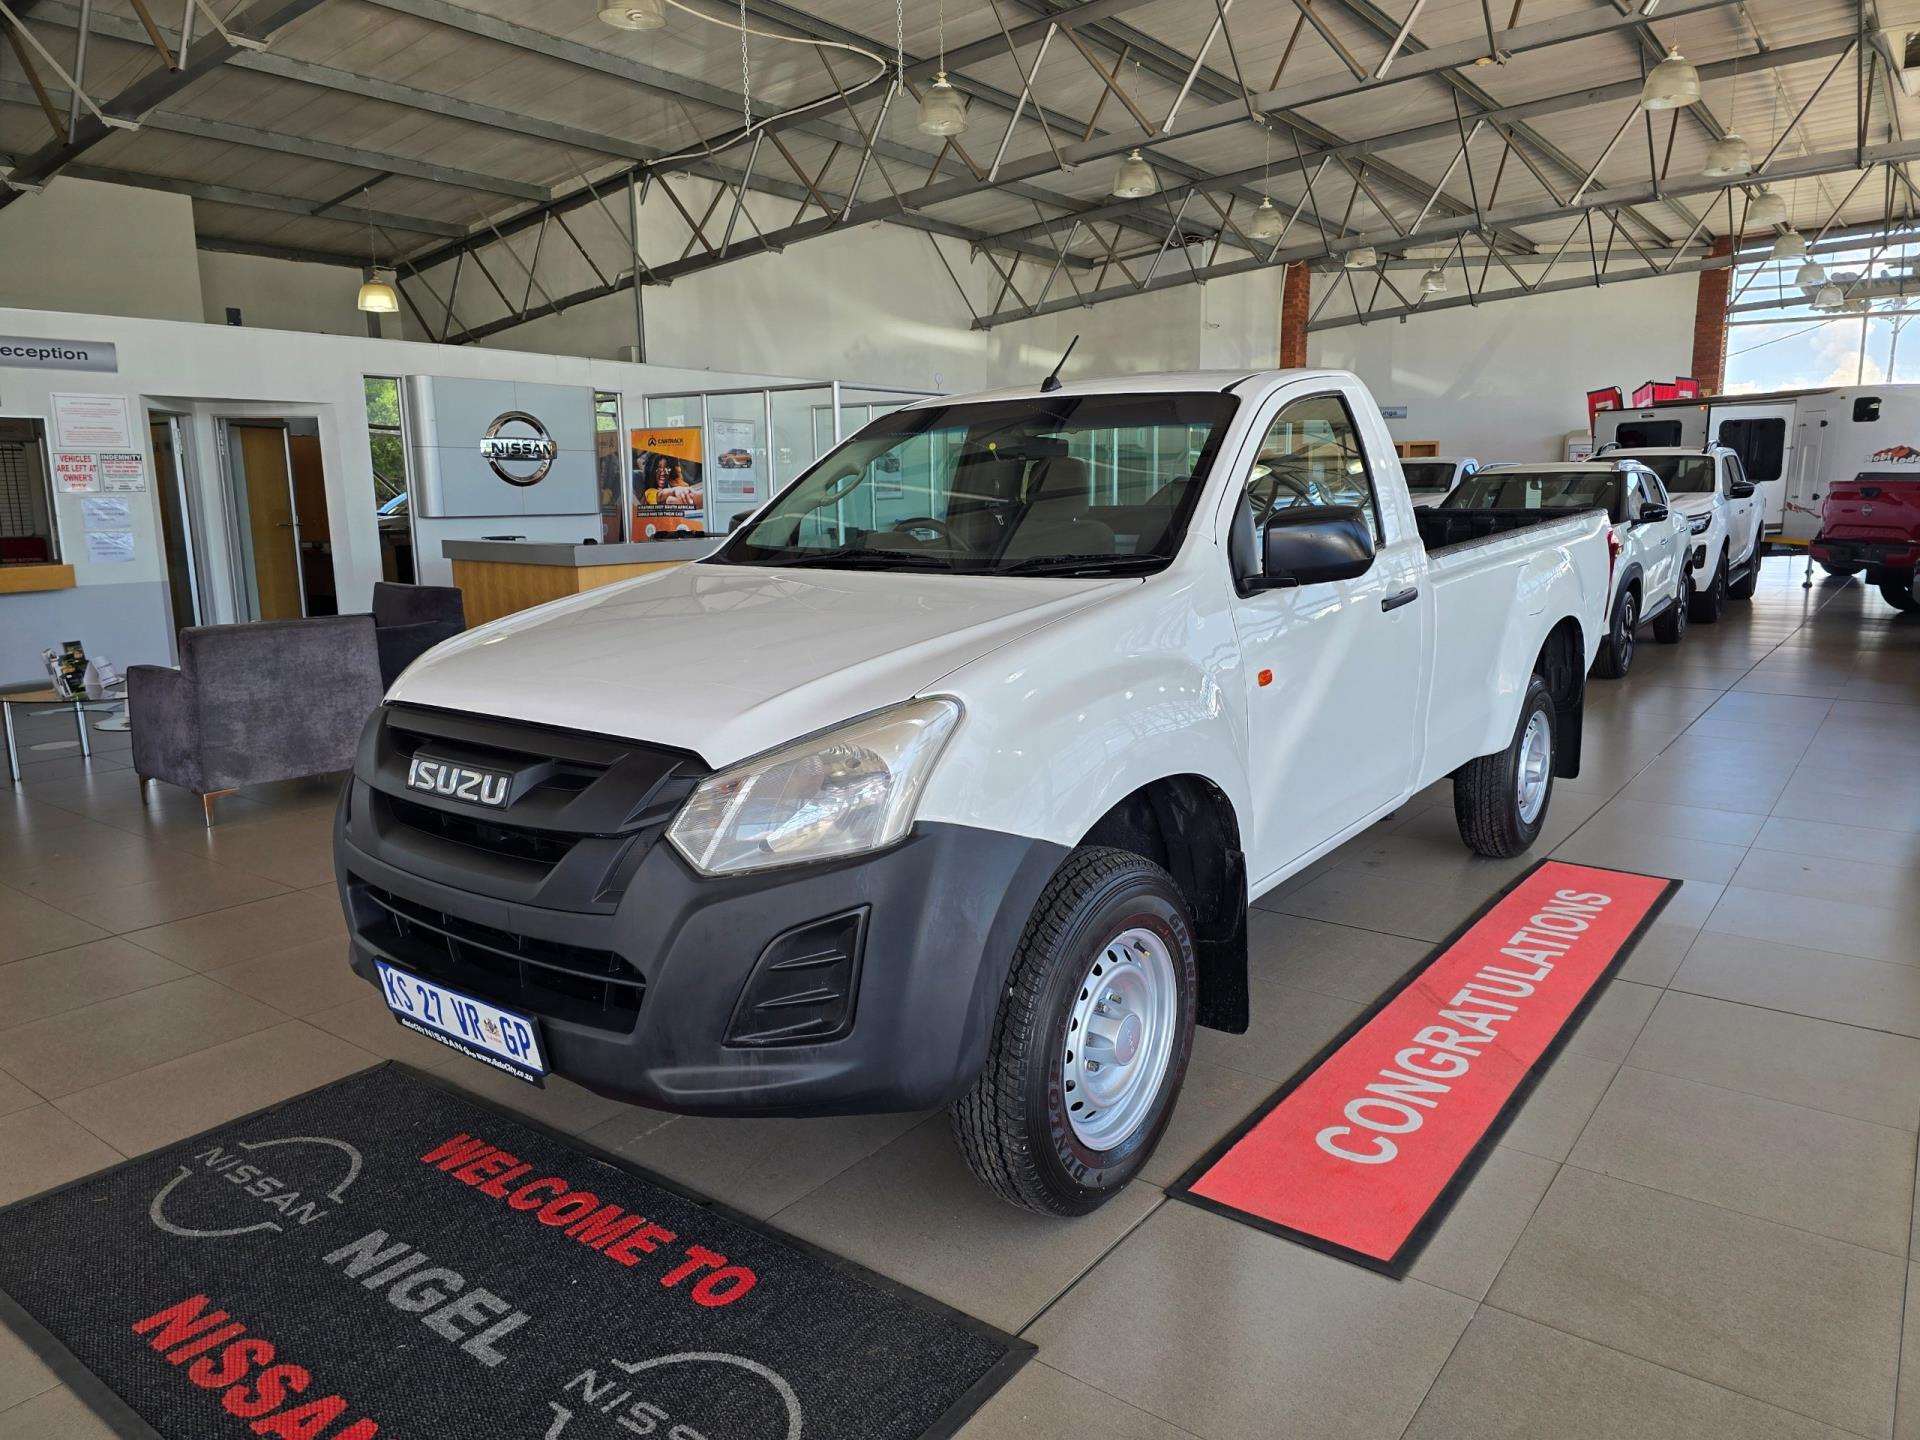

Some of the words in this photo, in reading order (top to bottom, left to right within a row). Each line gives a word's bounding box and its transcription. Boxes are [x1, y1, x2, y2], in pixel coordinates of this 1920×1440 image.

[0, 346, 88, 360] eception
[57, 464, 70, 473] ARE
[71, 464, 87, 473] LEFT
[89, 464, 97, 473] AT
[60, 455, 92, 463] VEHICLES
[491, 442, 551, 455] NISSAN
[63, 474, 93, 482] OWNER'S
[408, 758, 508, 806] ISUZU
[385, 967, 414, 1012] KS
[417, 984, 444, 1026] 27
[450, 998, 486, 1043] VR
[499, 1016, 531, 1061] GP
[1315, 889, 1612, 1165] CONGRATULATIONS
[425, 1029, 464, 1053] NISSAN
[195, 1146, 329, 1226] NISSAN
[420, 1133, 677, 1267] WELCOME
[660, 1244, 757, 1307] TO
[322, 1228, 532, 1368] NIGEL
[564, 1368, 710, 1440] NIS
